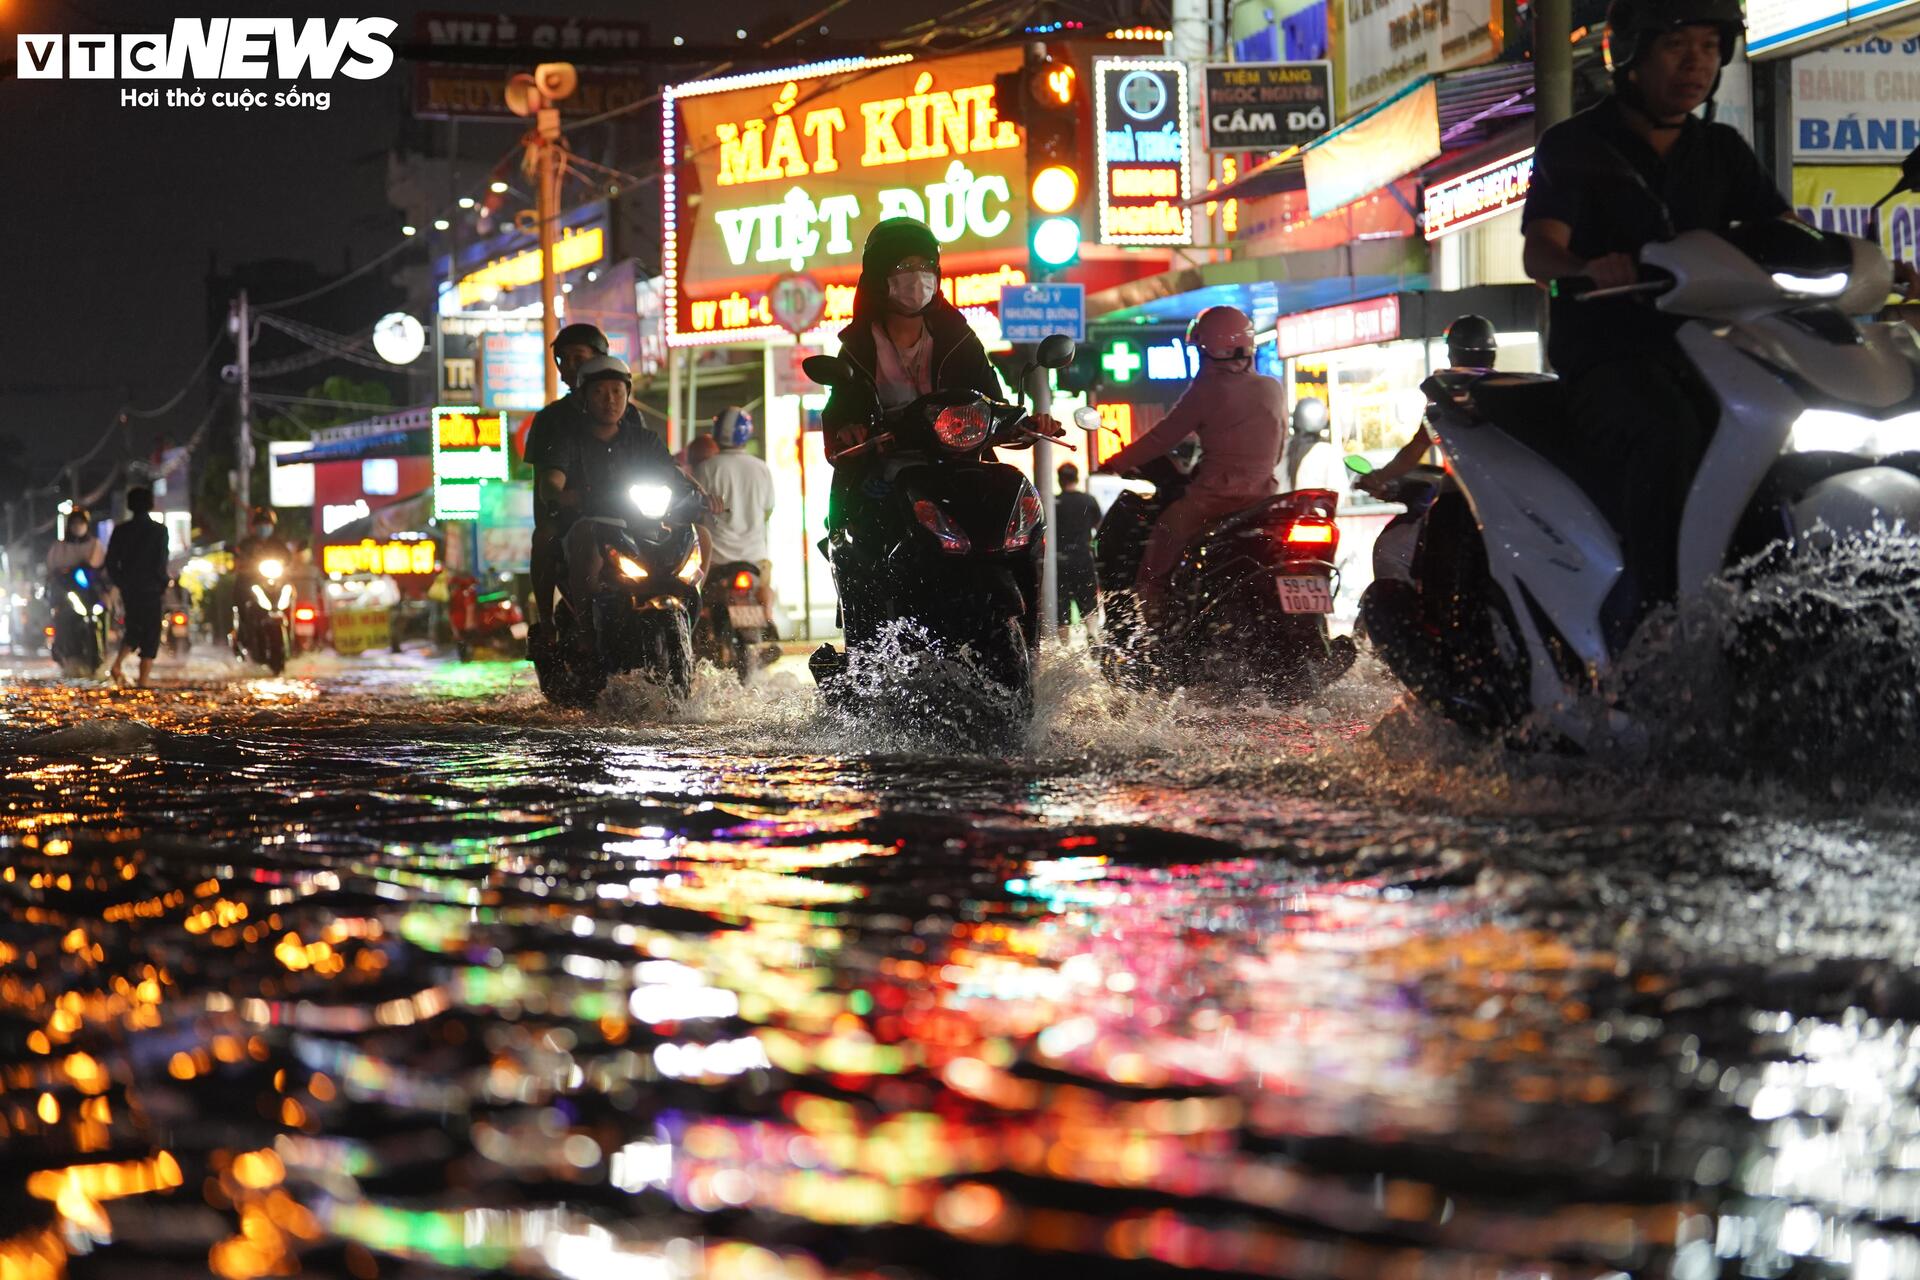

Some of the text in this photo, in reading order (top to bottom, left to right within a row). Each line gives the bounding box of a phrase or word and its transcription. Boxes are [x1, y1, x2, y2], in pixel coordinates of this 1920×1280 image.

[1222, 67, 1312, 85] TIỆM VÀNG
[716, 81, 847, 186] MẮT
[714, 186, 861, 272] VIỆT
